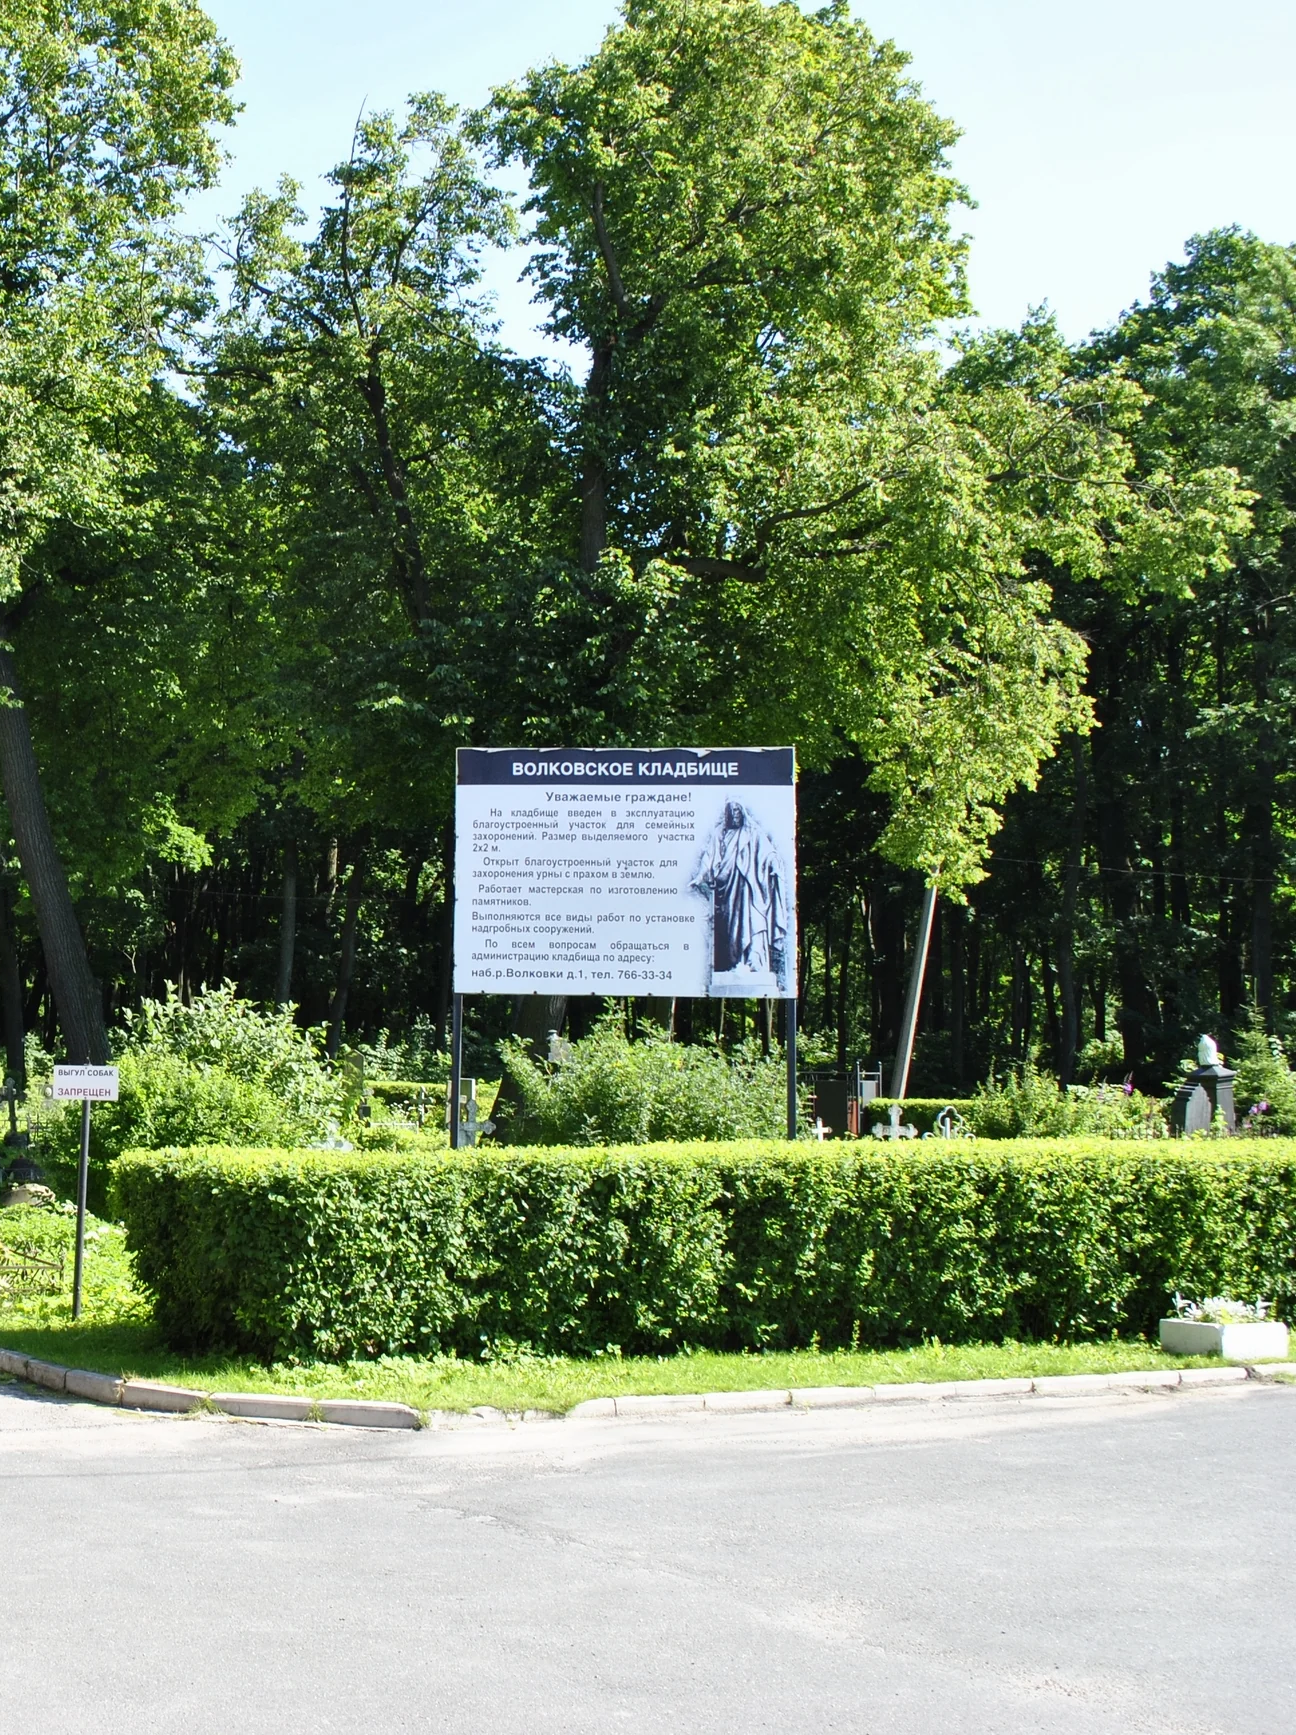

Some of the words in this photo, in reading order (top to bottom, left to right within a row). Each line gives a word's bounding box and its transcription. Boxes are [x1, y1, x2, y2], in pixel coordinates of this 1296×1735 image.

[512, 762, 633, 776] ВОЛКОВСКОЕ
[638, 762, 738, 778] КЛАДБИЩЕ
[545, 792, 621, 802] Уважаемые
[625, 792, 692, 804] граждане!
[490, 808, 502, 818] На
[511, 808, 558, 819] кладбище
[568, 810, 602, 818] введен
[611, 810, 617, 818] в
[626, 810, 695, 820] эксплуатацию
[472, 820, 558, 830] благоустроенный
[569, 822, 606, 830] участок
[616, 822, 635, 830] для
[645, 820, 695, 829] семейных
[472, 832, 537, 843] захоронений.
[541, 832, 577, 843] Размер
[581, 833, 648, 842] выделяемого
[657, 833, 695, 843] участка
[483, 857, 520, 868] Открыт
[524, 857, 611, 869] благоустроенный
[616, 859, 654, 869] участок
[659, 859, 678, 868] для
[472, 870, 533, 880] захоронения
[536, 871, 562, 880] урны
[573, 871, 609, 880] прахом
[620, 871, 655, 879] землю.
[478, 885, 522, 894] Работает
[529, 886, 583, 896] мастерская
[590, 886, 602, 894] по
[608, 887, 678, 895] изготовлению
[472, 898, 532, 906] памятников.
[472, 912, 540, 921] Выполняются
[545, 914, 562, 922] все
[566, 914, 593, 922] виды
[597, 913, 625, 923] работ
[645, 915, 695, 924] установке
[471, 923, 531, 934] надгробных
[533, 924, 595, 935] сооружений.
[485, 939, 498, 948] По
[511, 941, 536, 949] всем
[549, 941, 597, 951] вопросам
[610, 941, 670, 951] обращаться
[684, 943, 690, 951] в
[471, 952, 549, 962] администрацию
[552, 953, 600, 963] кладбища
[603, 954, 615, 962] по
[617, 954, 655, 964] адресу:
[471, 968, 563, 979] наб.р.Волковки
[567, 970, 587, 980] д.1,
[591, 971, 614, 979] тел.
[617, 970, 672, 980] 766-33-34
[58, 1088, 111, 1097] ЗАПРЕЩЕН
